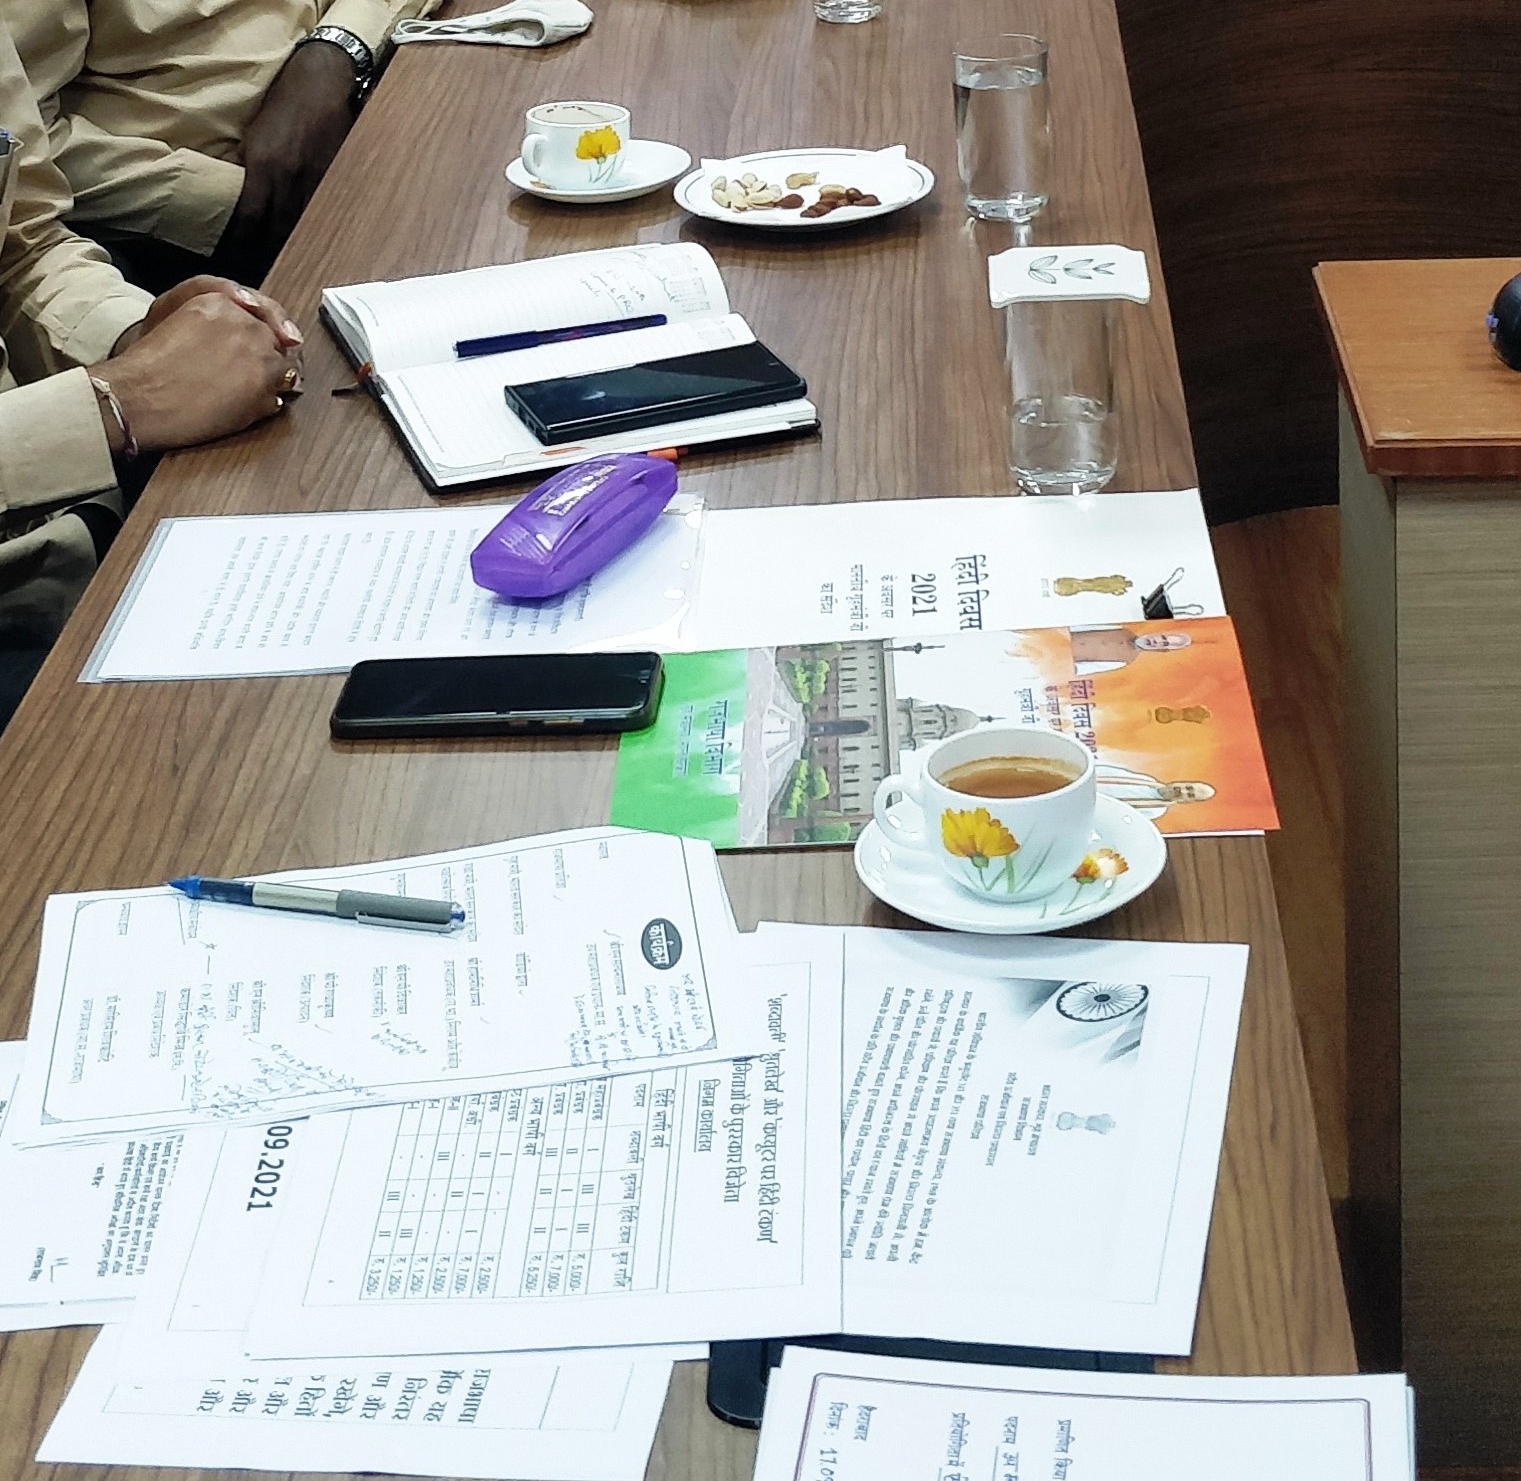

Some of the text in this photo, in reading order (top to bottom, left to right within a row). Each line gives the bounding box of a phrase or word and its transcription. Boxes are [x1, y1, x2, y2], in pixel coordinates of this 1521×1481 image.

[910, 573, 937, 617] 2021
[951, 555, 990, 630] हिंदी दिवस
